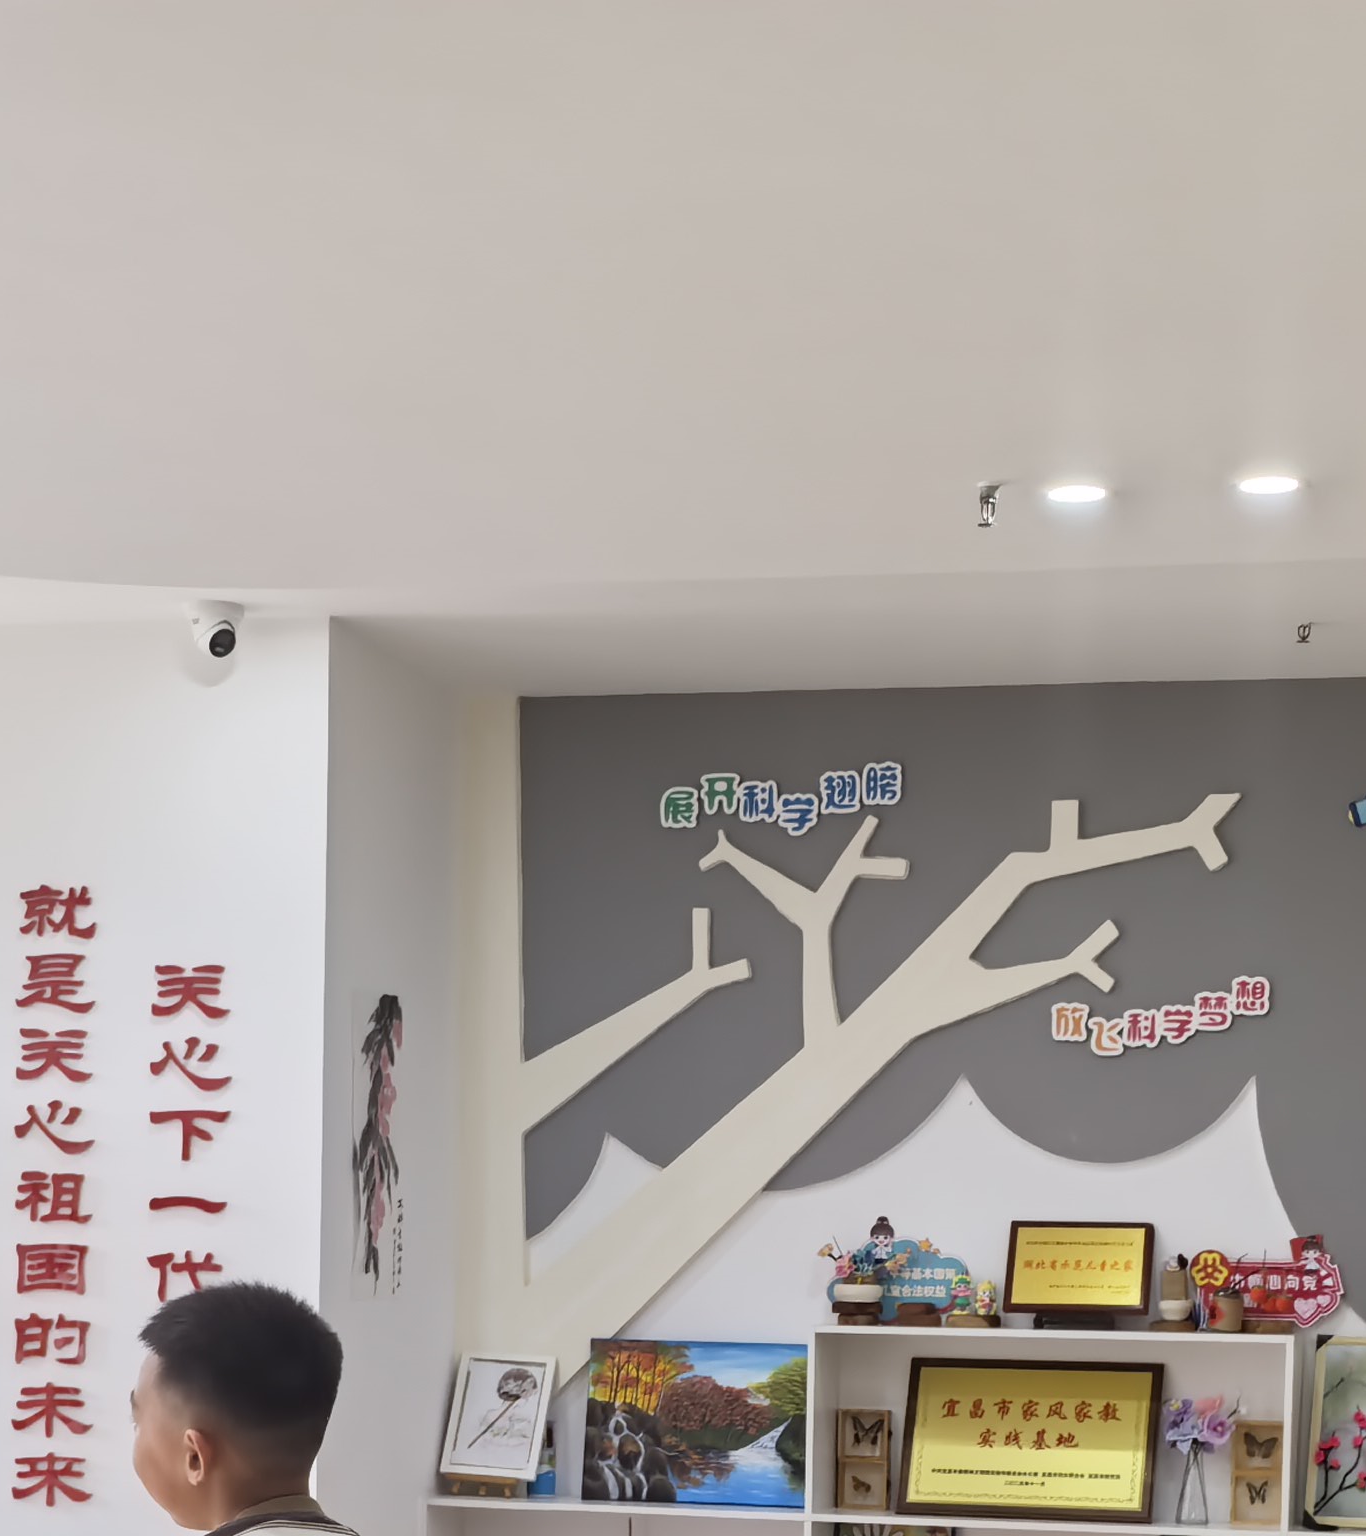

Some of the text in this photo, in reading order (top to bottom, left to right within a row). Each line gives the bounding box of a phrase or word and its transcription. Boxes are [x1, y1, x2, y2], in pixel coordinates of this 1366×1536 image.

[664, 764, 899, 833] 展开科学翅膀
[1054, 979, 1267, 1054] 放飞科学梦想
[10, 884, 97, 1507] 就是关心祖国的未来
[940, 1398, 1122, 1423] 宜昌市家风家教
[976, 1428, 1080, 1450] 实践基地
